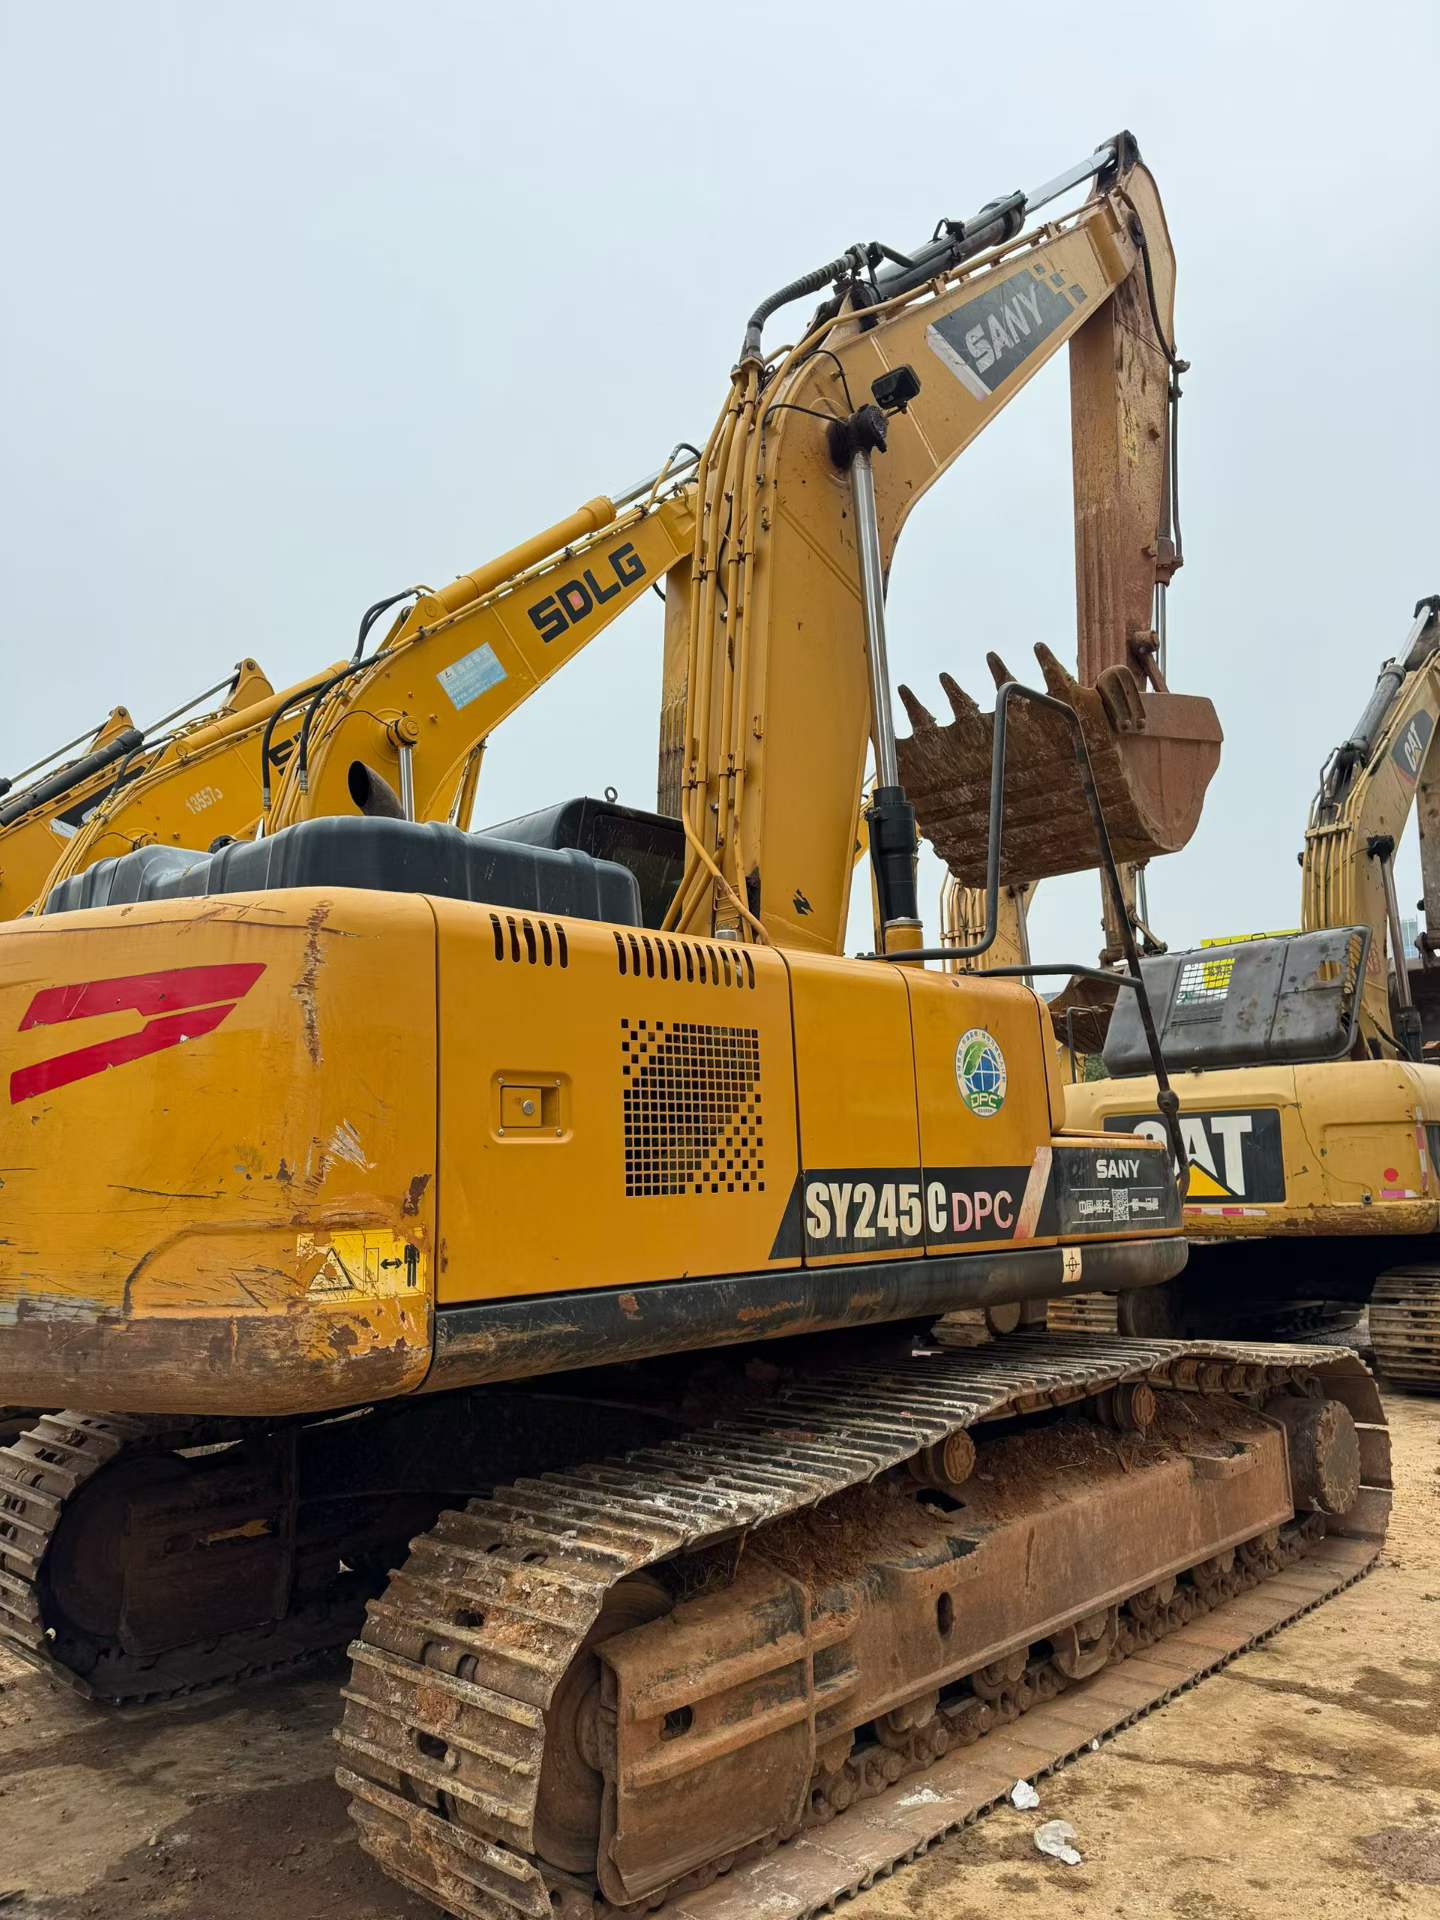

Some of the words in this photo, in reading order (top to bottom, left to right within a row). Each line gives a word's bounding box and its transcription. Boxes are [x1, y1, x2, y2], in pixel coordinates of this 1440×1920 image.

[966, 282, 1042, 374] SANY
[527, 542, 647, 644] SDLG
[1404, 720, 1423, 772] CAT
[970, 1093, 998, 1107] DPC
[1095, 1159, 1140, 1179] SANY
[951, 1190, 1014, 1232] DPC
